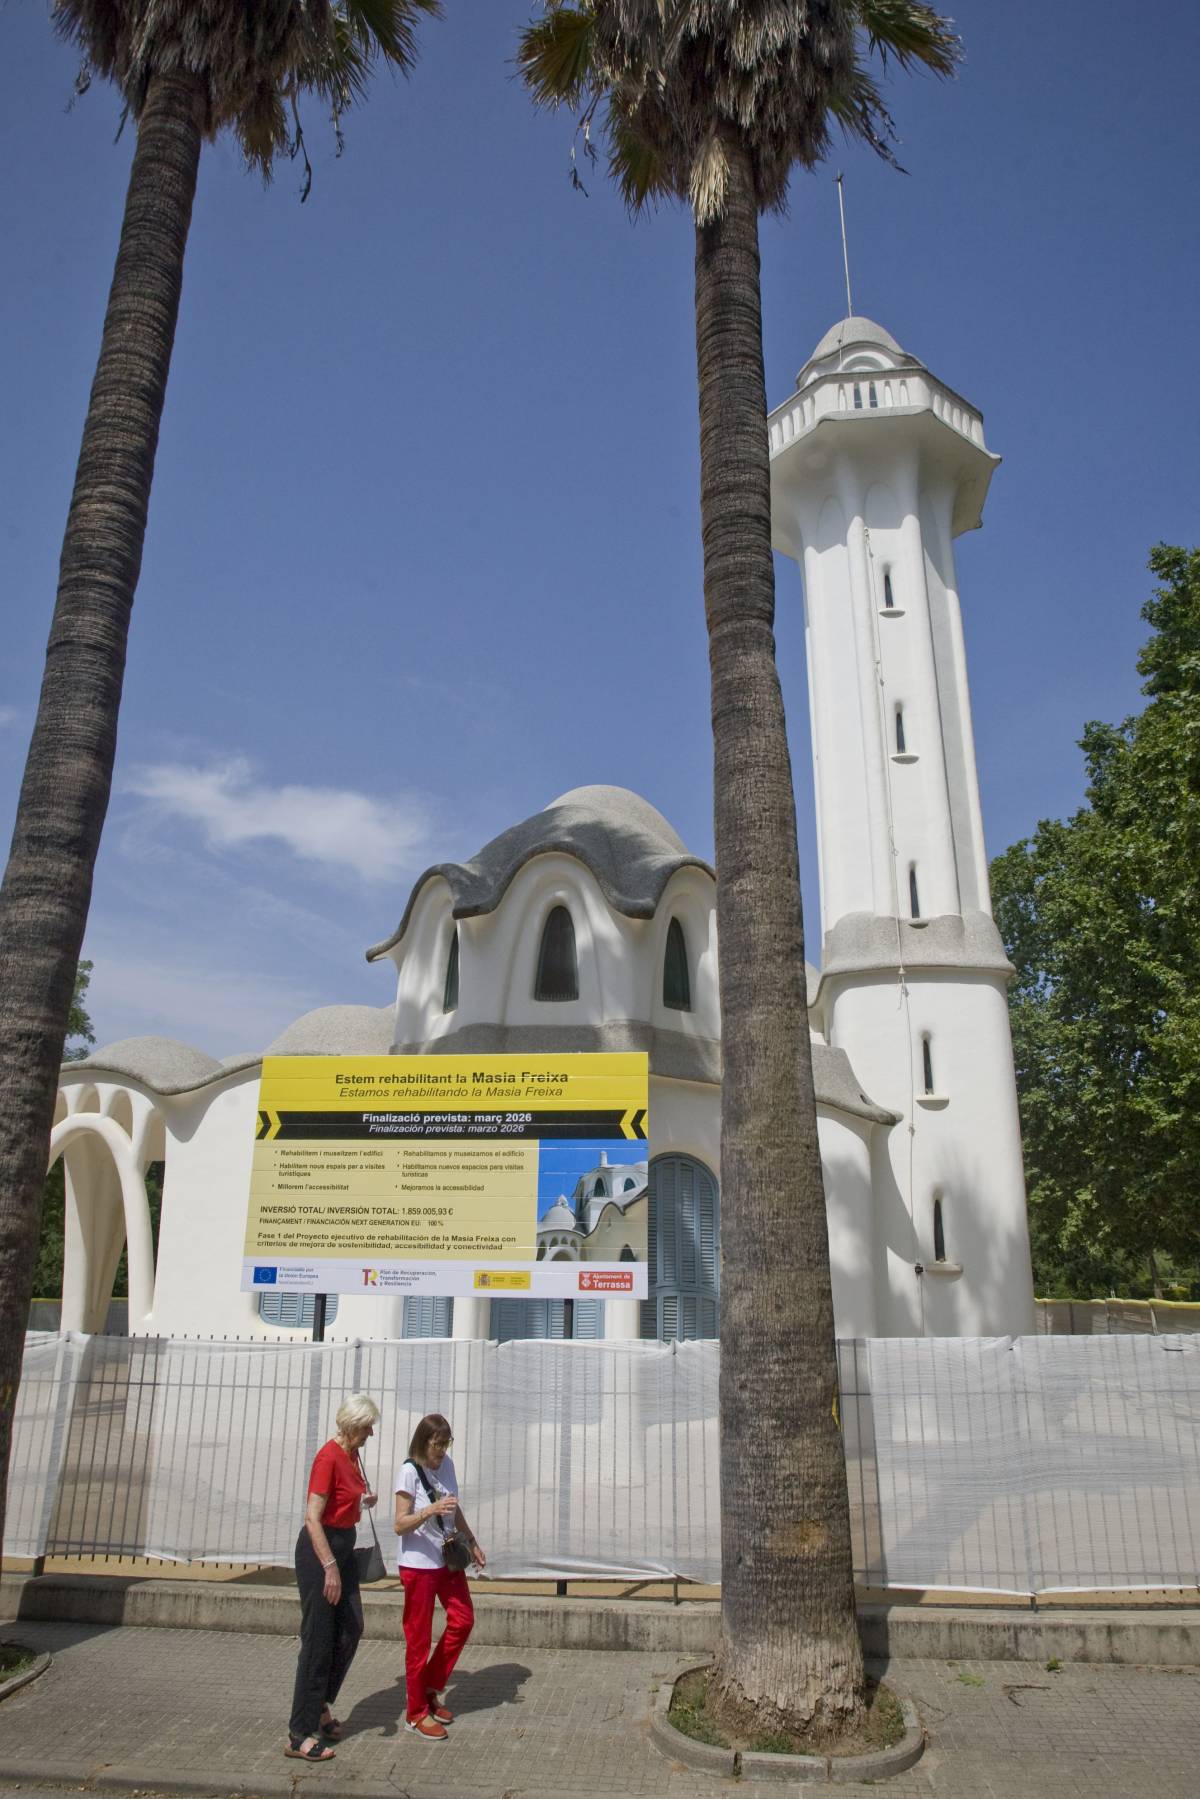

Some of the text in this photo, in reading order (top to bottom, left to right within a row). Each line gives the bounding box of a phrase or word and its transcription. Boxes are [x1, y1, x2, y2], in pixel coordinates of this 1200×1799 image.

[336, 1072, 569, 1084] Estem rehabilitant la Masia Freixa
[340, 1087, 563, 1097] Estamos rehabilitando la Masia Freixa
[362, 1113, 532, 1125] Finalizació prevista: març 2026
[369, 1124, 424, 1133] Finalización
[426, 1125, 465, 1134] prevista:
[500, 1124, 524, 1133] 2026
[402, 1184, 434, 1192] Mejoramos
[261, 1205, 296, 1214] INVERSIÓ
[327, 1206, 369, 1215] INVERSIÓN
[402, 1208, 447, 1216] 1.859.005,93
[297, 1233, 329, 1241] Proyecto
[593, 1280, 630, 1288] Terrassa
